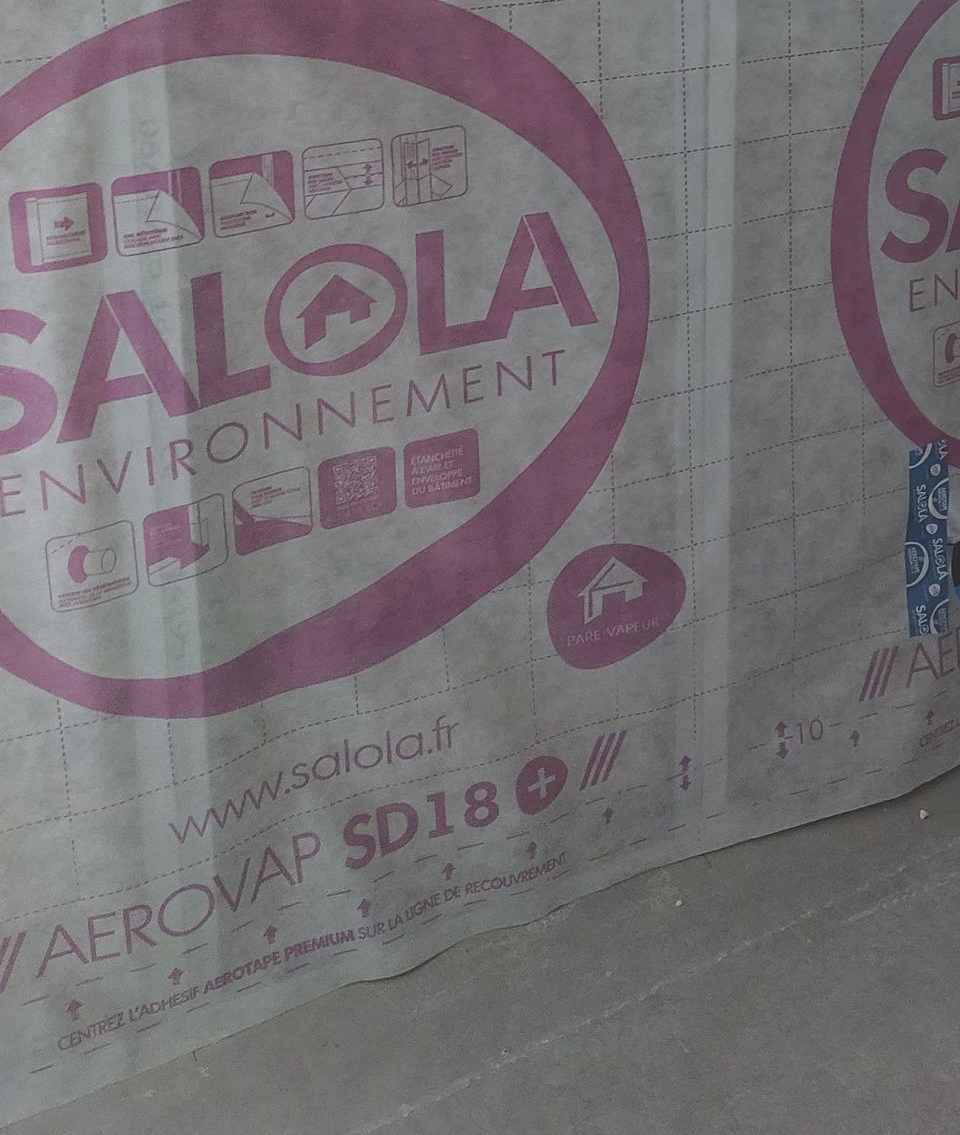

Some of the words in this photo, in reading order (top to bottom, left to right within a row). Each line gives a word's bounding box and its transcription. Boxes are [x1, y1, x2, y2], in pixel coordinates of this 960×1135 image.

[0, 349, 566, 518] ENVIRONNEMENT
[411, 486, 426, 496] DU
[916, 484, 929, 524] SALOLA
[932, 536, 950, 580] SALOLA
[567, 629, 601, 646] PARE
[606, 616, 660, 637] VAPEUR
[796, 719, 824, 746] 10
[170, 715, 460, 846] www.salola.fr
[36, 832, 321, 979] AEROVAP
[343, 781, 500, 869] SD18
[58, 1012, 125, 1050] CENTREZ
[204, 950, 280, 993] AEROTAPE
[285, 930, 356, 962] PREMIUM
[358, 923, 386, 941] SUR
[388, 914, 403, 932] LA
[405, 892, 441, 922] LIGNE
[444, 887, 462, 903] DE
[464, 852, 569, 896] RECOUVREMENT
